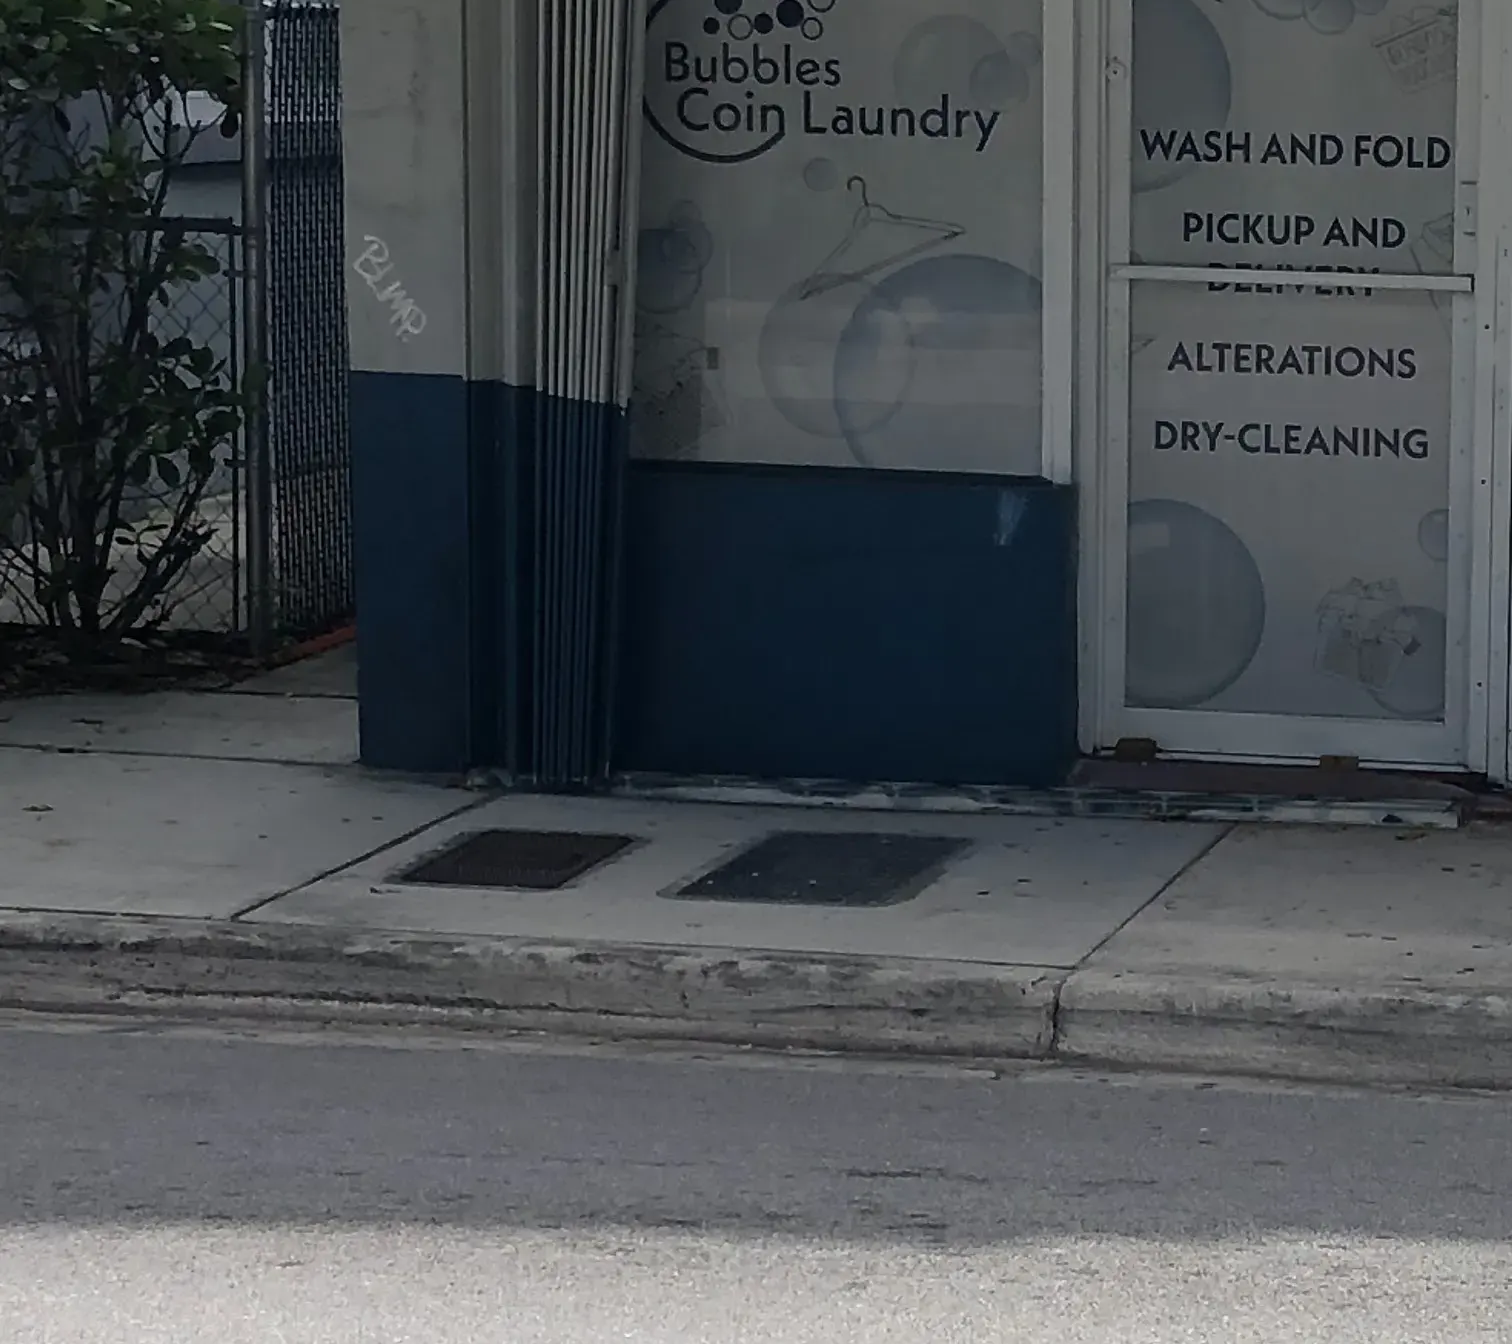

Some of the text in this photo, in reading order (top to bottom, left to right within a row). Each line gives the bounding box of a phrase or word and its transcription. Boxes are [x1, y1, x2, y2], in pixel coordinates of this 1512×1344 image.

[664, 41, 841, 87] Bubbles
[676, 87, 1001, 153] Coin Laundry
[1139, 128, 1452, 169] WASH AND FOLD
[1182, 211, 1407, 249] PICKUP AND
[1166, 341, 1417, 380] ALTERATIONS
[1154, 419, 1430, 460] DRY-CLEANING
